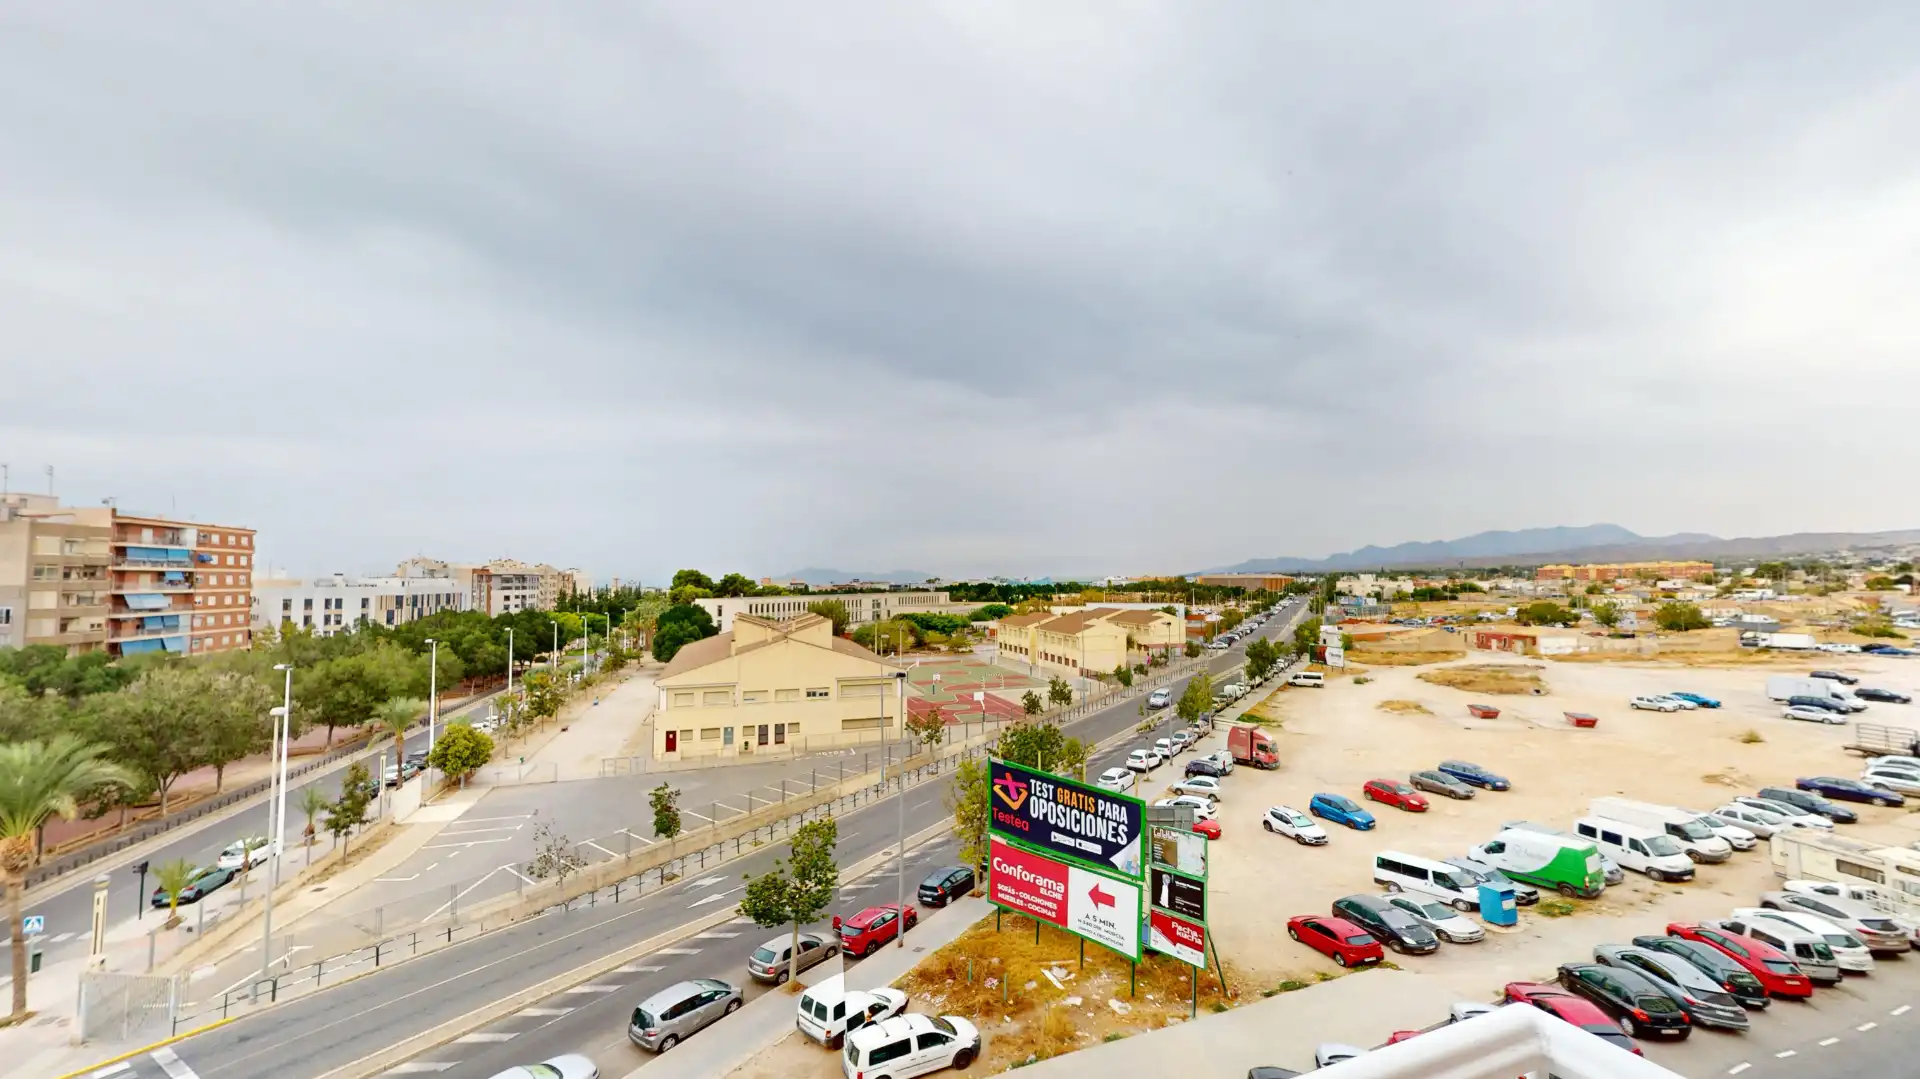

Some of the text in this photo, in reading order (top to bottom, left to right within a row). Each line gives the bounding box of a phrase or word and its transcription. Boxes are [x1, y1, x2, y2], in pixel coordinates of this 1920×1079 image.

[1030, 779, 1128, 825] TEST GRATIS PARA
[992, 807, 1028, 832] Testea
[1029, 796, 1128, 846] OPOSICIONES
[993, 856, 1065, 893] Conforama
[1019, 891, 1058, 910] COLCHONES
[1040, 887, 1063, 900] ELCHE
